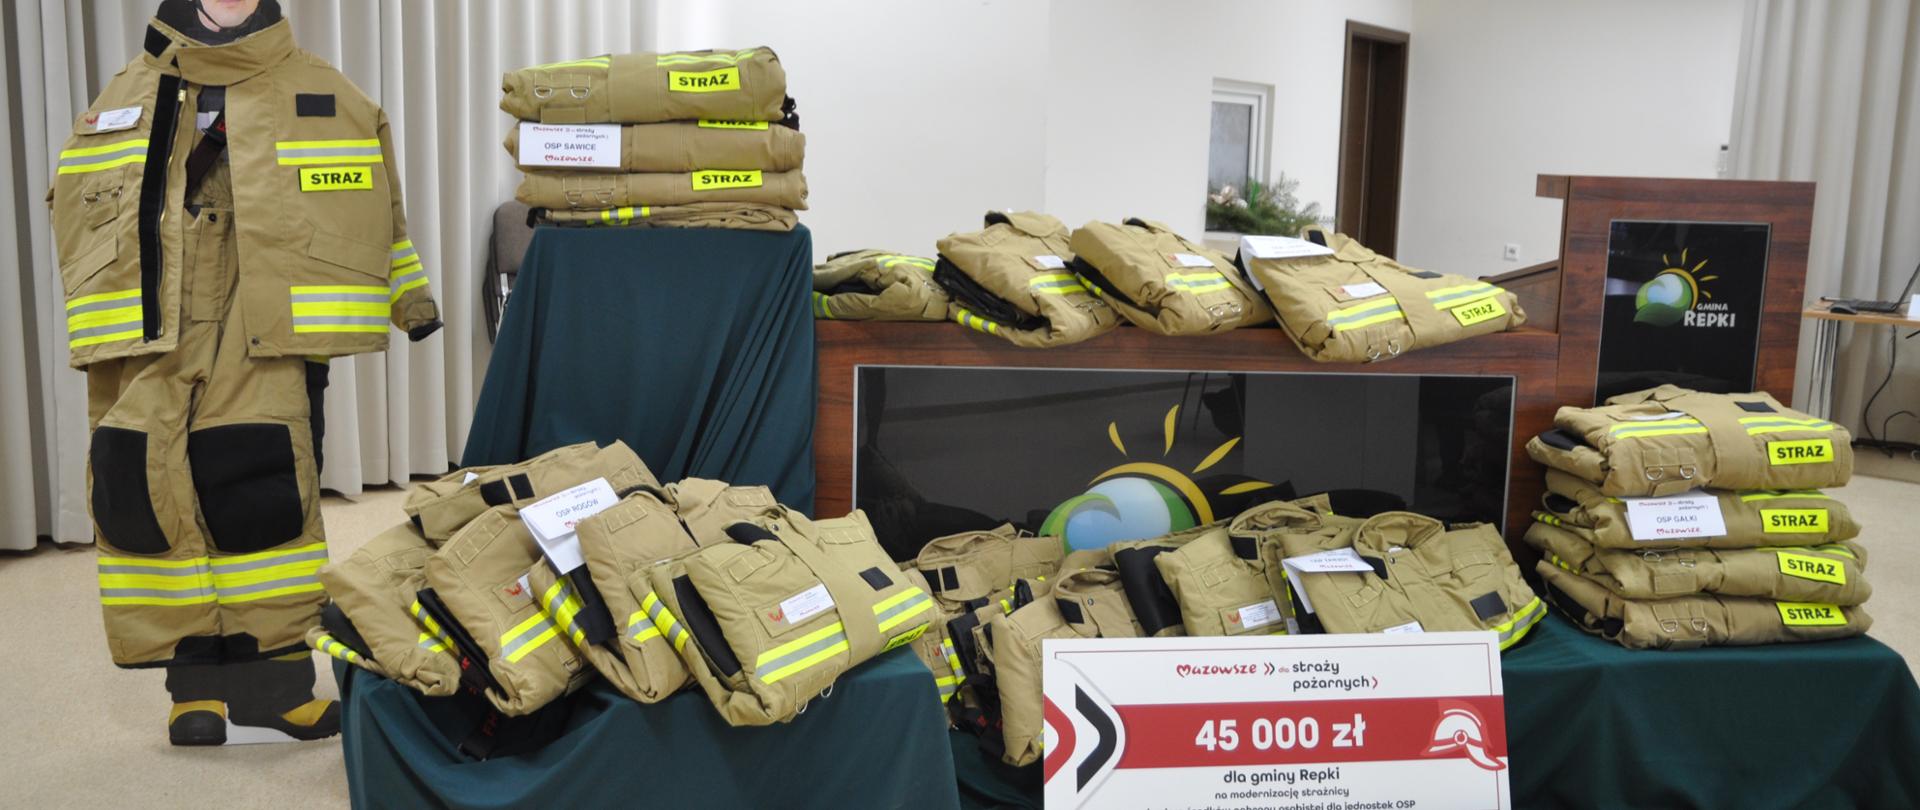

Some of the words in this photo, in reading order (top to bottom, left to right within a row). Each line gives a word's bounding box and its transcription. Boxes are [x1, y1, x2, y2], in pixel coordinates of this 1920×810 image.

[544, 142, 562, 150] OSP
[564, 142, 596, 151] SAWICE
[1696, 303, 1728, 311] GMINA
[1684, 311, 1736, 328] REPKI
[1176, 663, 1257, 678] Mazowsze
[1292, 659, 1340, 675] straży
[1293, 676, 1370, 692] pożarnych
[1195, 719, 1239, 751] 45
[1251, 716, 1320, 750] 000
[1332, 713, 1366, 748] zł
[1223, 770, 1247, 783] dla
[1250, 769, 1295, 786] gminy
[1300, 767, 1340, 783] Repki
[1230, 788, 1299, 799] modernizację
[1301, 786, 1350, 797] strażnicy
[1326, 802, 1342, 810] dla
[1344, 800, 1394, 810] jednostek
[1396, 800, 1416, 809] OSP
